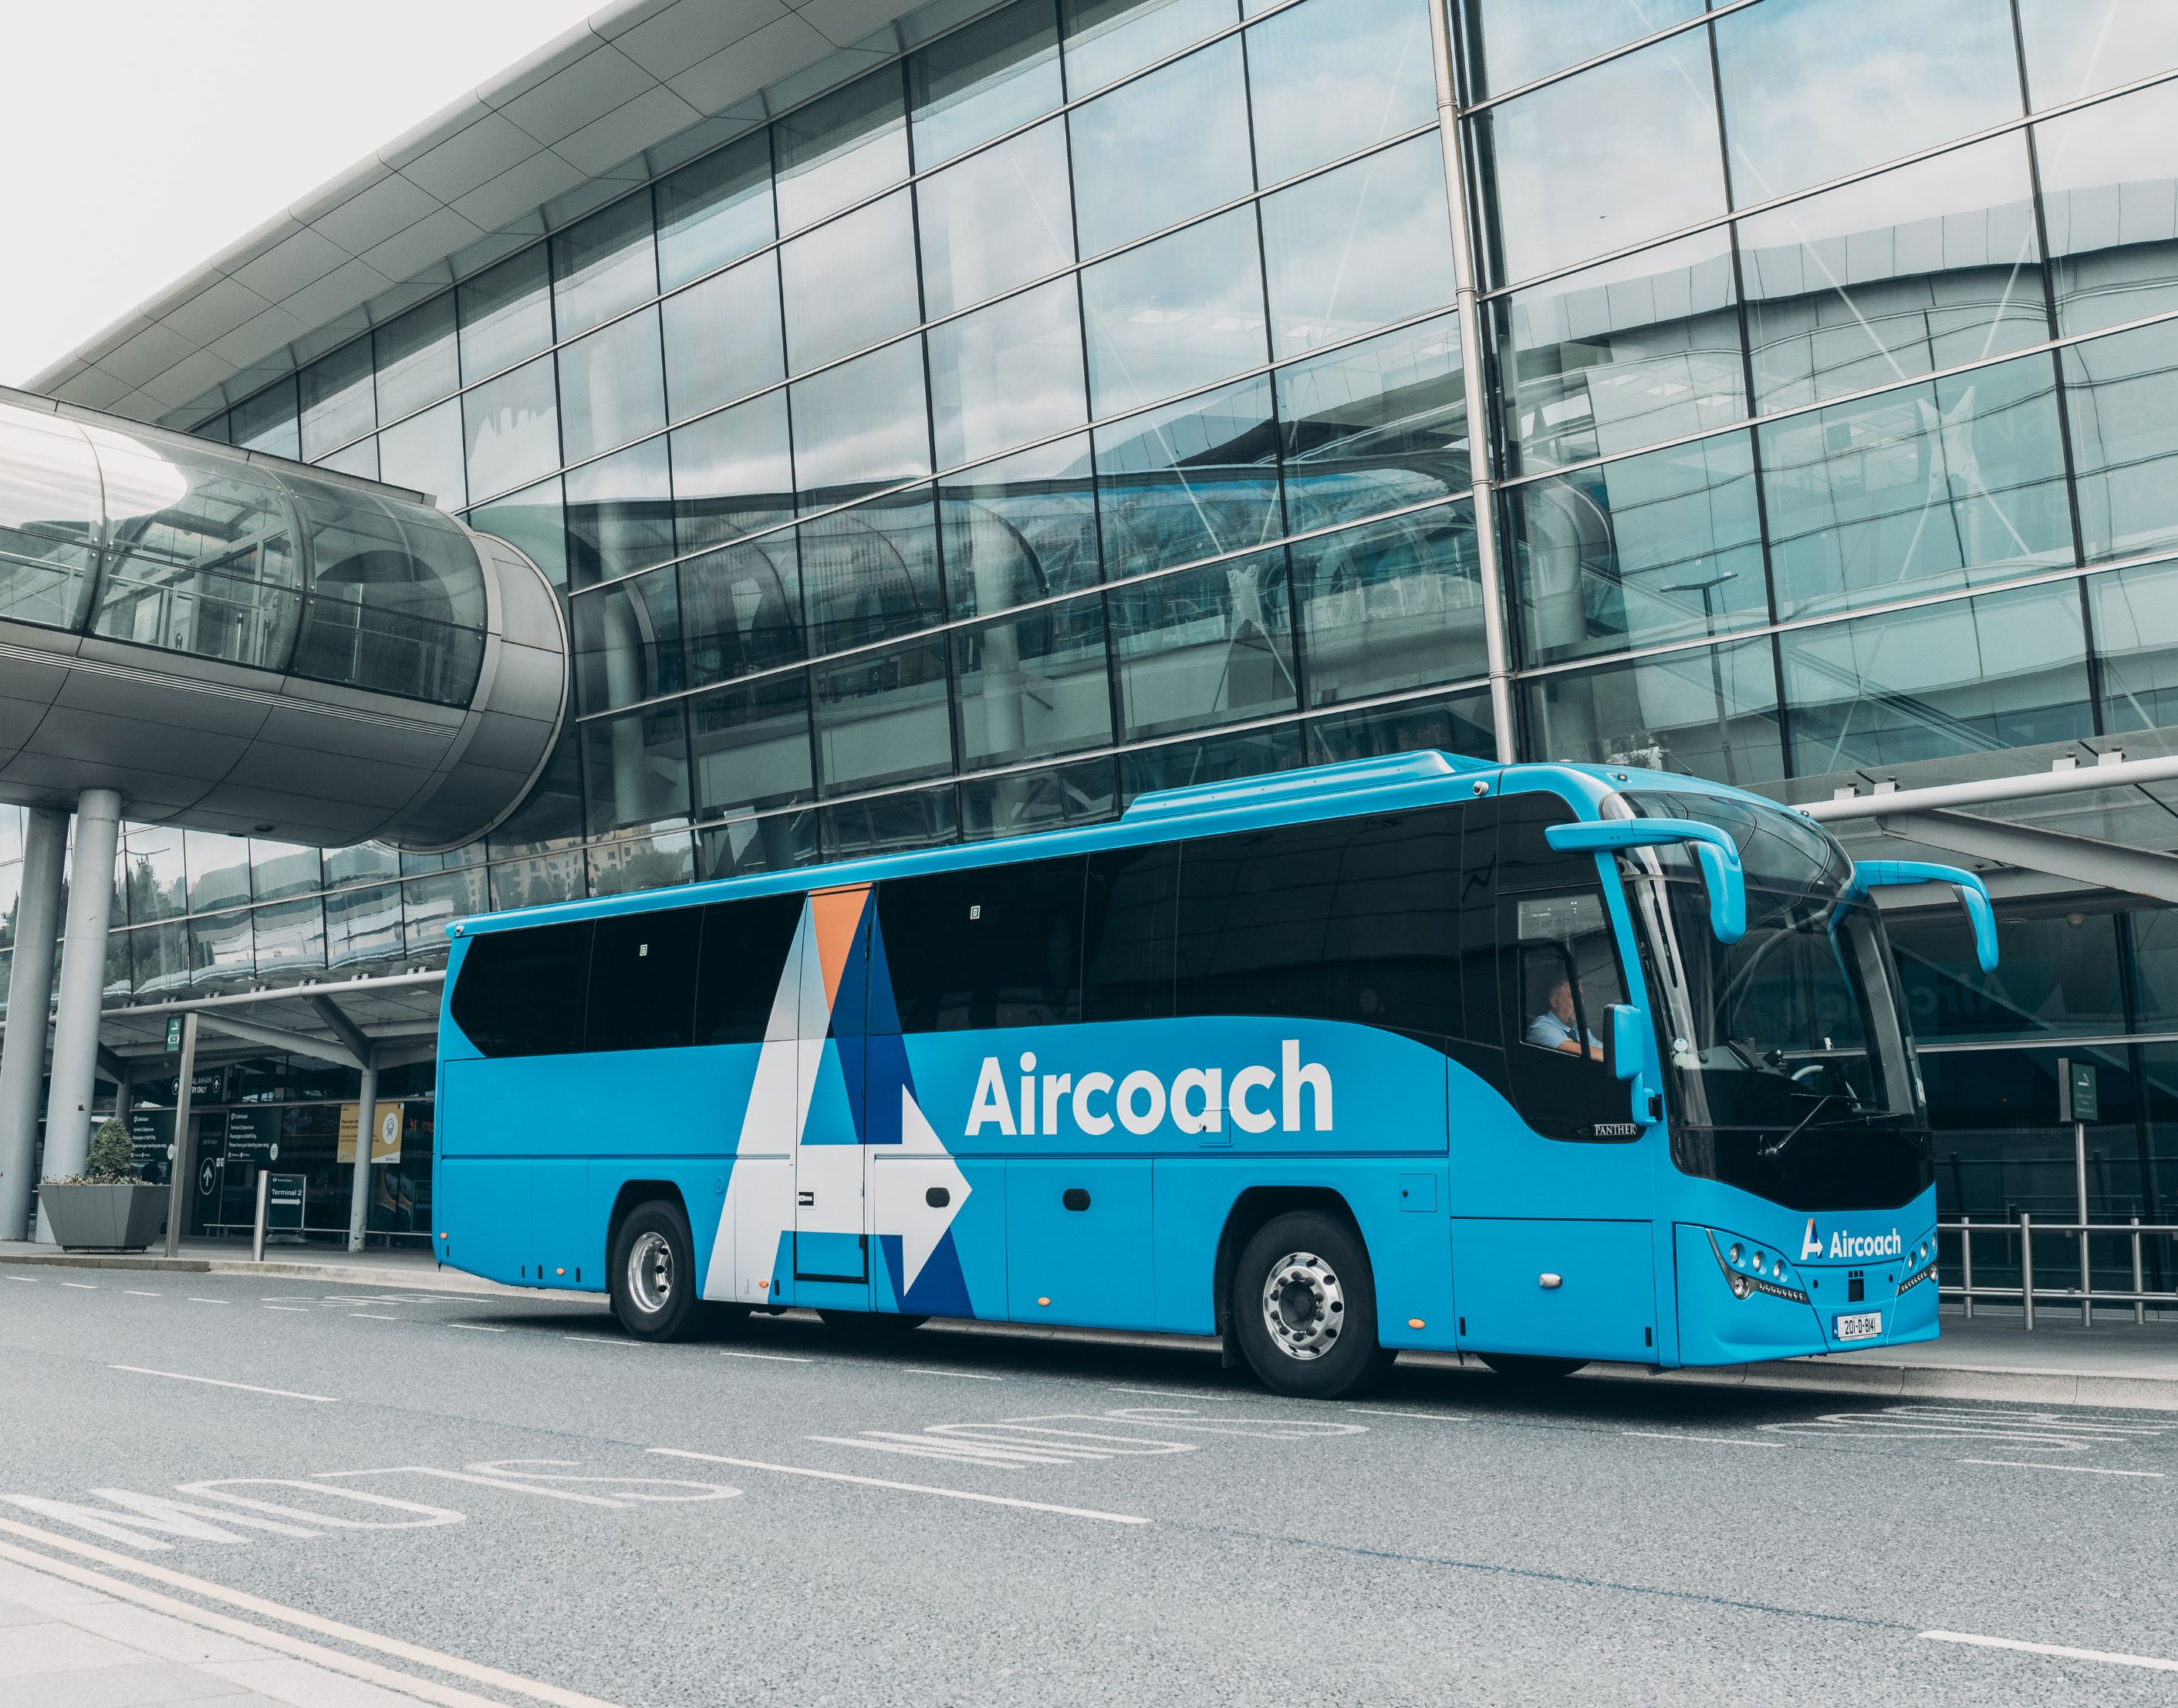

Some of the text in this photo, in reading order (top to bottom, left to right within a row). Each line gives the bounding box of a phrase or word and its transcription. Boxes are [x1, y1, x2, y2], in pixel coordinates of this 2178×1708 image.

[964, 1039, 1333, 1136] Aircoach
[1594, 1125, 1636, 1135] PANTHER
[1829, 1228, 1901, 1258] Aircoach
[1845, 1318, 1876, 1335] 201-D-8141
[804, 1408, 1370, 1470] SLOW
[0, 1459, 744, 1551] SLOW
